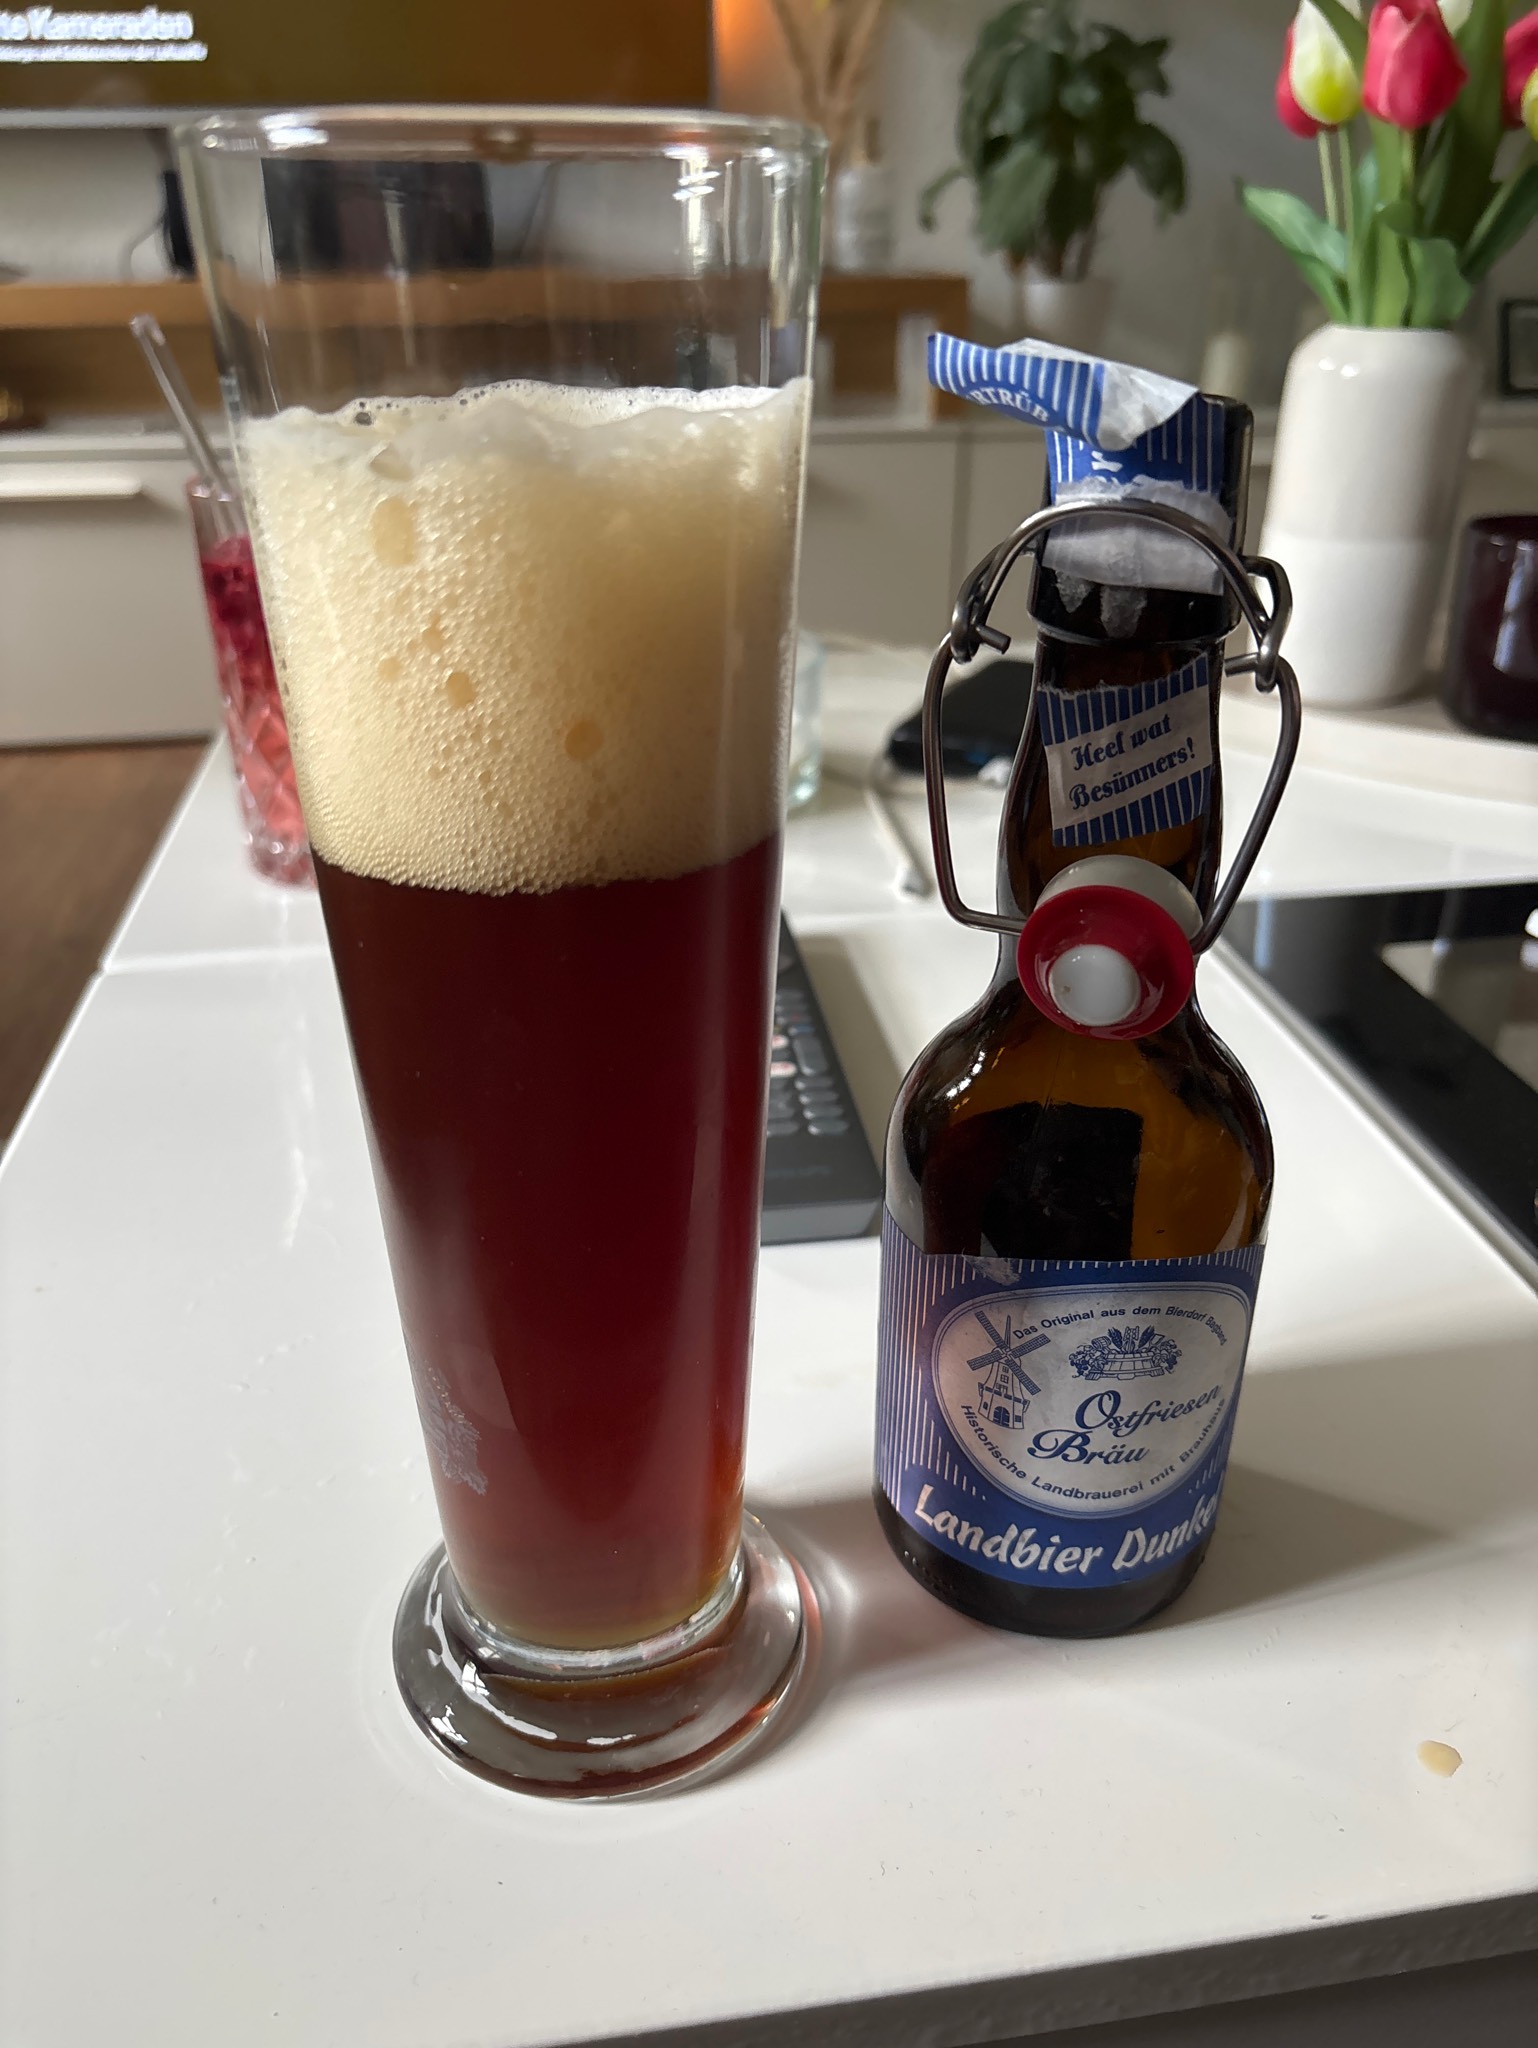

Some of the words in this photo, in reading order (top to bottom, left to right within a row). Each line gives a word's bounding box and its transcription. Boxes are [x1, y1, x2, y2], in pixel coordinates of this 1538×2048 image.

[1130, 714, 1172, 749] wat
[1069, 737, 1195, 810] Besünners!
[1013, 1325, 1038, 1339] Das
[1041, 1310, 1094, 1328] Original
[1101, 1308, 1126, 1318] aus
[1132, 1306, 1161, 1315] dem
[1165, 1306, 1208, 1322] Bierdorf
[1075, 1385, 1221, 1438] Ostfriesen
[961, 1405, 1027, 1479] Historische
[1031, 1476, 1144, 1500] Landbrauerei
[1150, 1465, 1175, 1485] mit
[1027, 1429, 1150, 1465] Bräu
[915, 1484, 1103, 1575] Landbier
